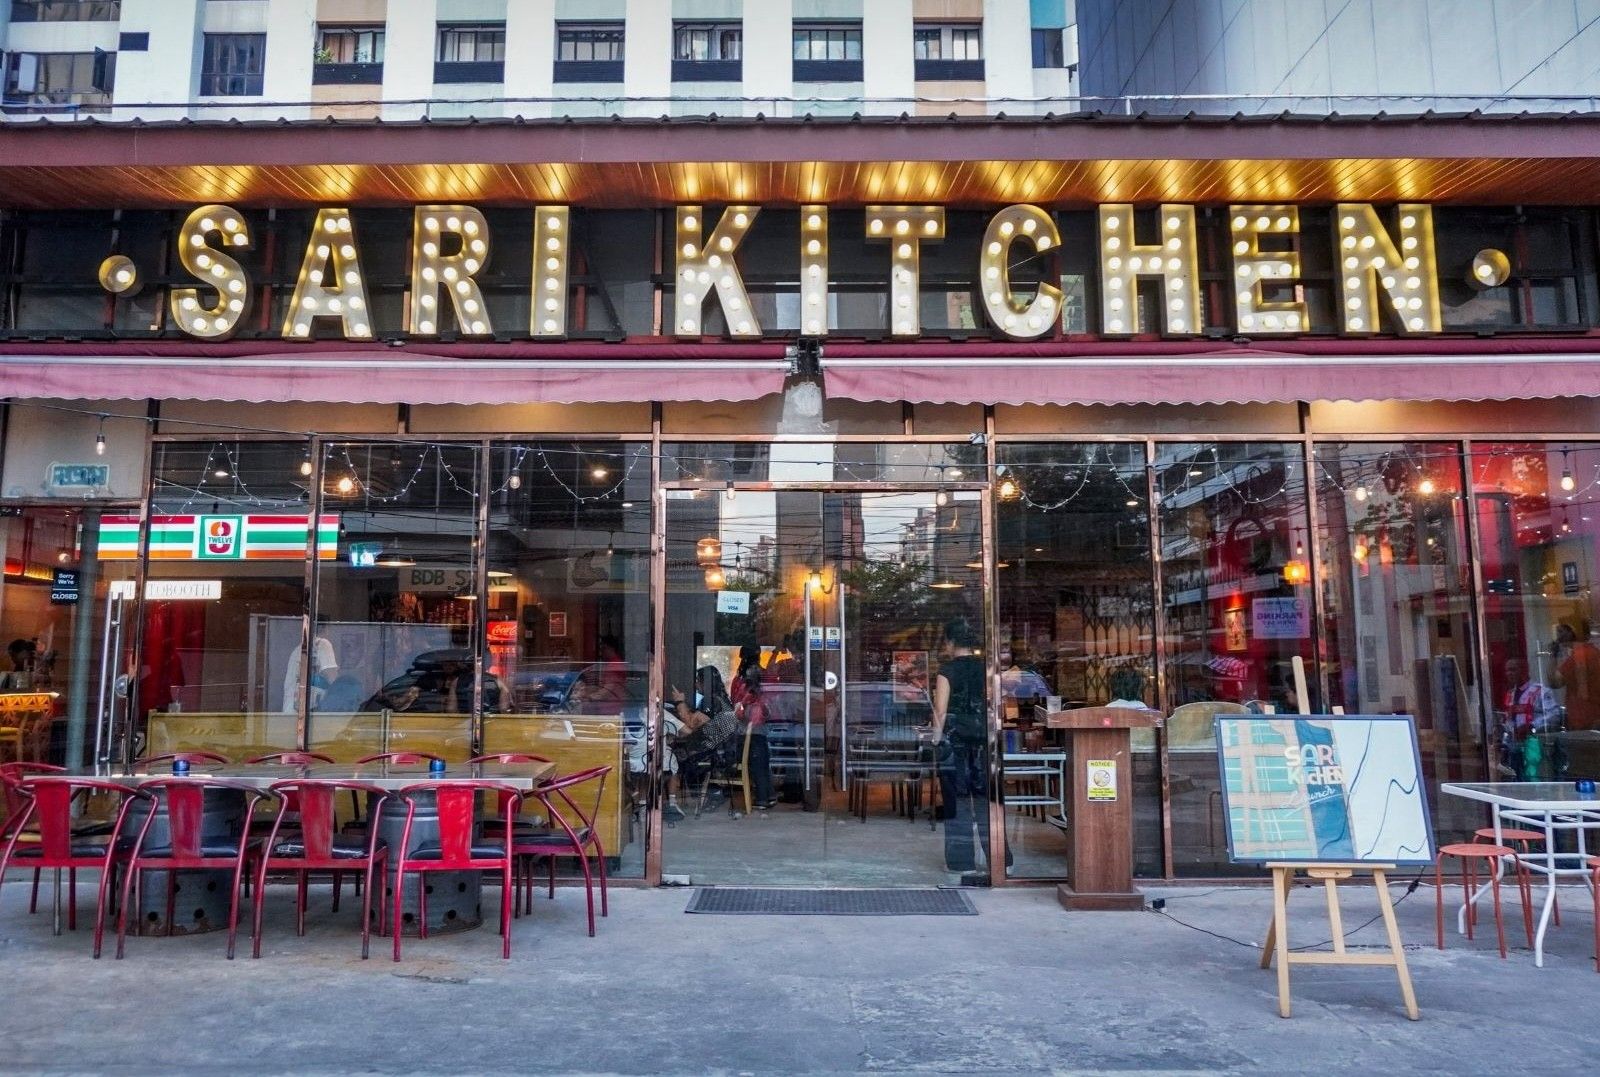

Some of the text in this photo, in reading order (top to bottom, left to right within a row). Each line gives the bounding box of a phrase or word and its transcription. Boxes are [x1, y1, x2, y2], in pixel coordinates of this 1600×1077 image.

[170, 203, 1441, 338] SARI KITCHEN
[208, 536, 233, 544] TWELVE
[411, 569, 444, 586] BDB
